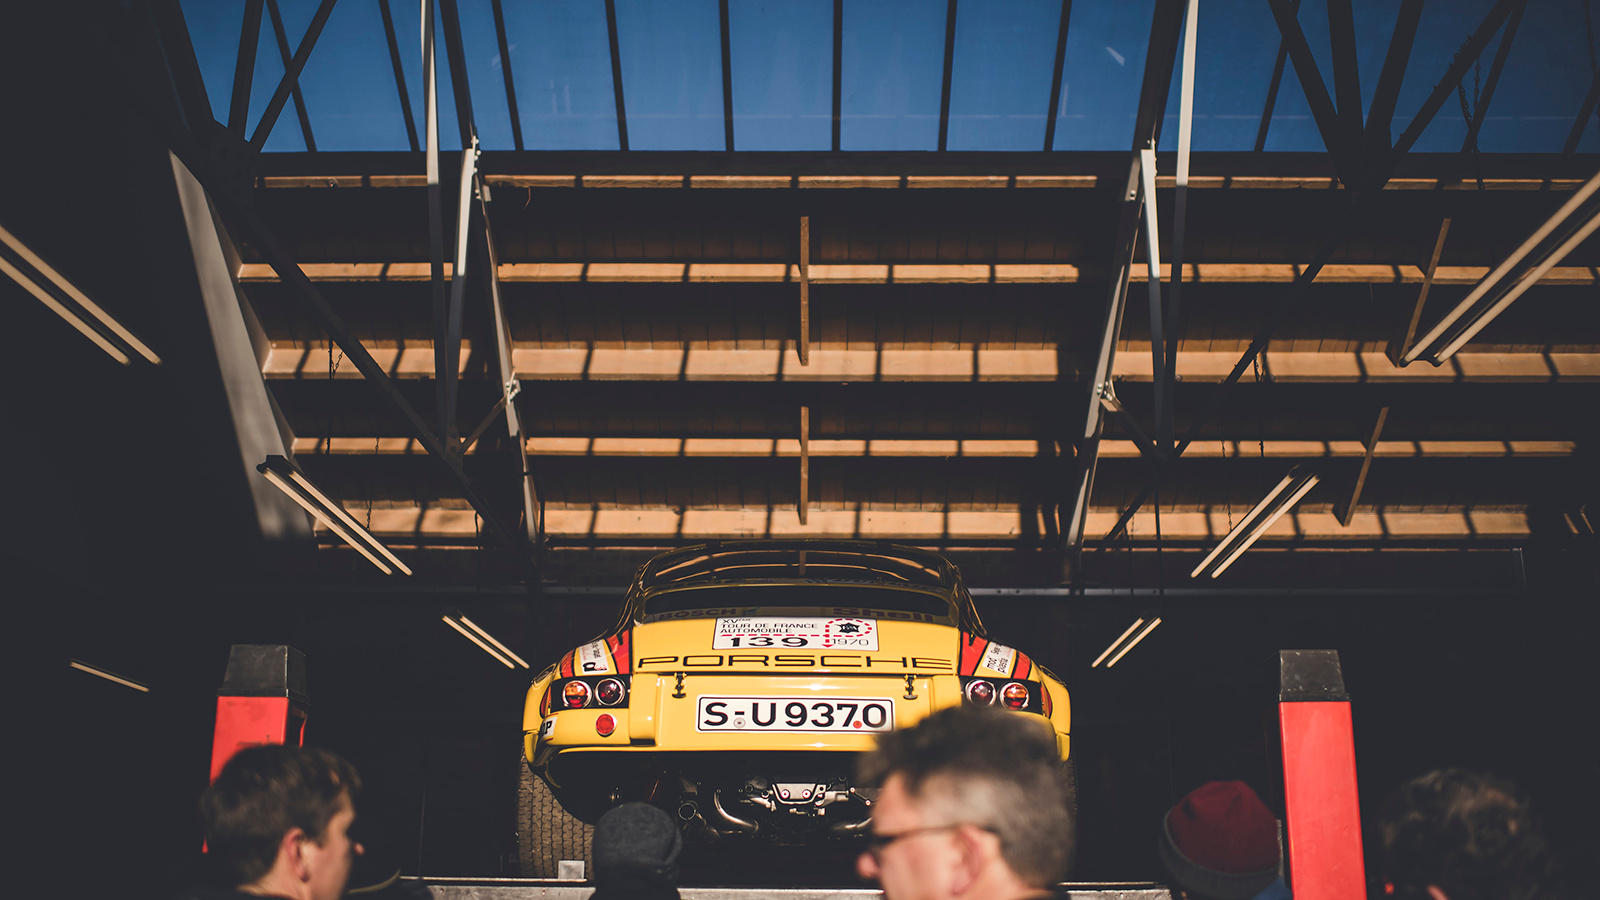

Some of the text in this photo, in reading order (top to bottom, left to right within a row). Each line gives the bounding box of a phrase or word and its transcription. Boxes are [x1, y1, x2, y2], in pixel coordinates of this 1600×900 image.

[658, 608, 737, 621] BOSCH
[833, 607, 934, 622] Shell
[730, 637, 809, 647] 139
[831, 638, 869, 646] 1970
[638, 655, 953, 670] PORSCHE
